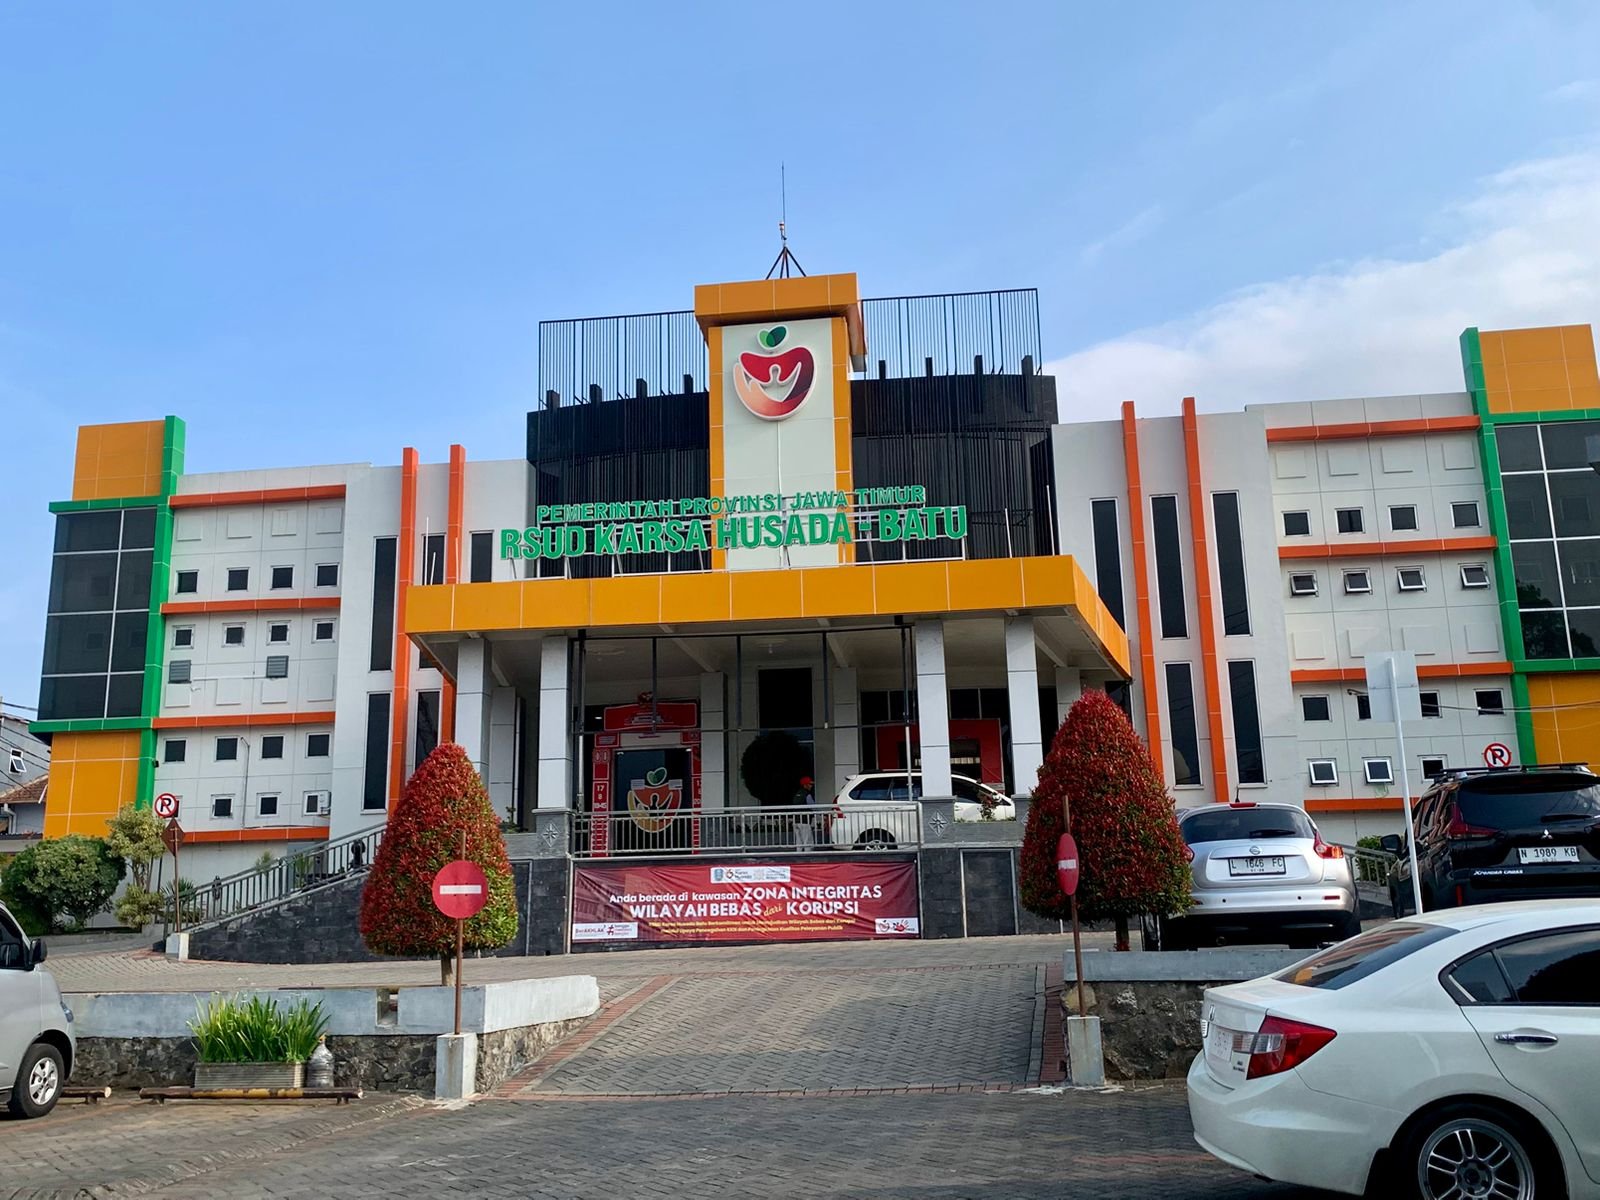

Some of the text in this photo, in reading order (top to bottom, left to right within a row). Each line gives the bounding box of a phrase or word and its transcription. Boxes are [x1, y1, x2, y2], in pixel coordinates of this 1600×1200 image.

[537, 485, 925, 522] PEMERINTAH PROVINSI JAWA TIMUR
[500, 526, 586, 560] RSUD
[594, 519, 708, 555] KARSA
[716, 512, 852, 549] HUSADA
[878, 505, 967, 542] BATU
[1520, 847, 1577, 858] N 1989 KB
[1231, 859, 1237, 869] L
[1271, 857, 1282, 867] FC
[609, 885, 882, 903] Anda berada di kawasan ZONA INTEGRITAS
[629, 901, 859, 918] WILAYAH BEBAS dari KORUPSI
